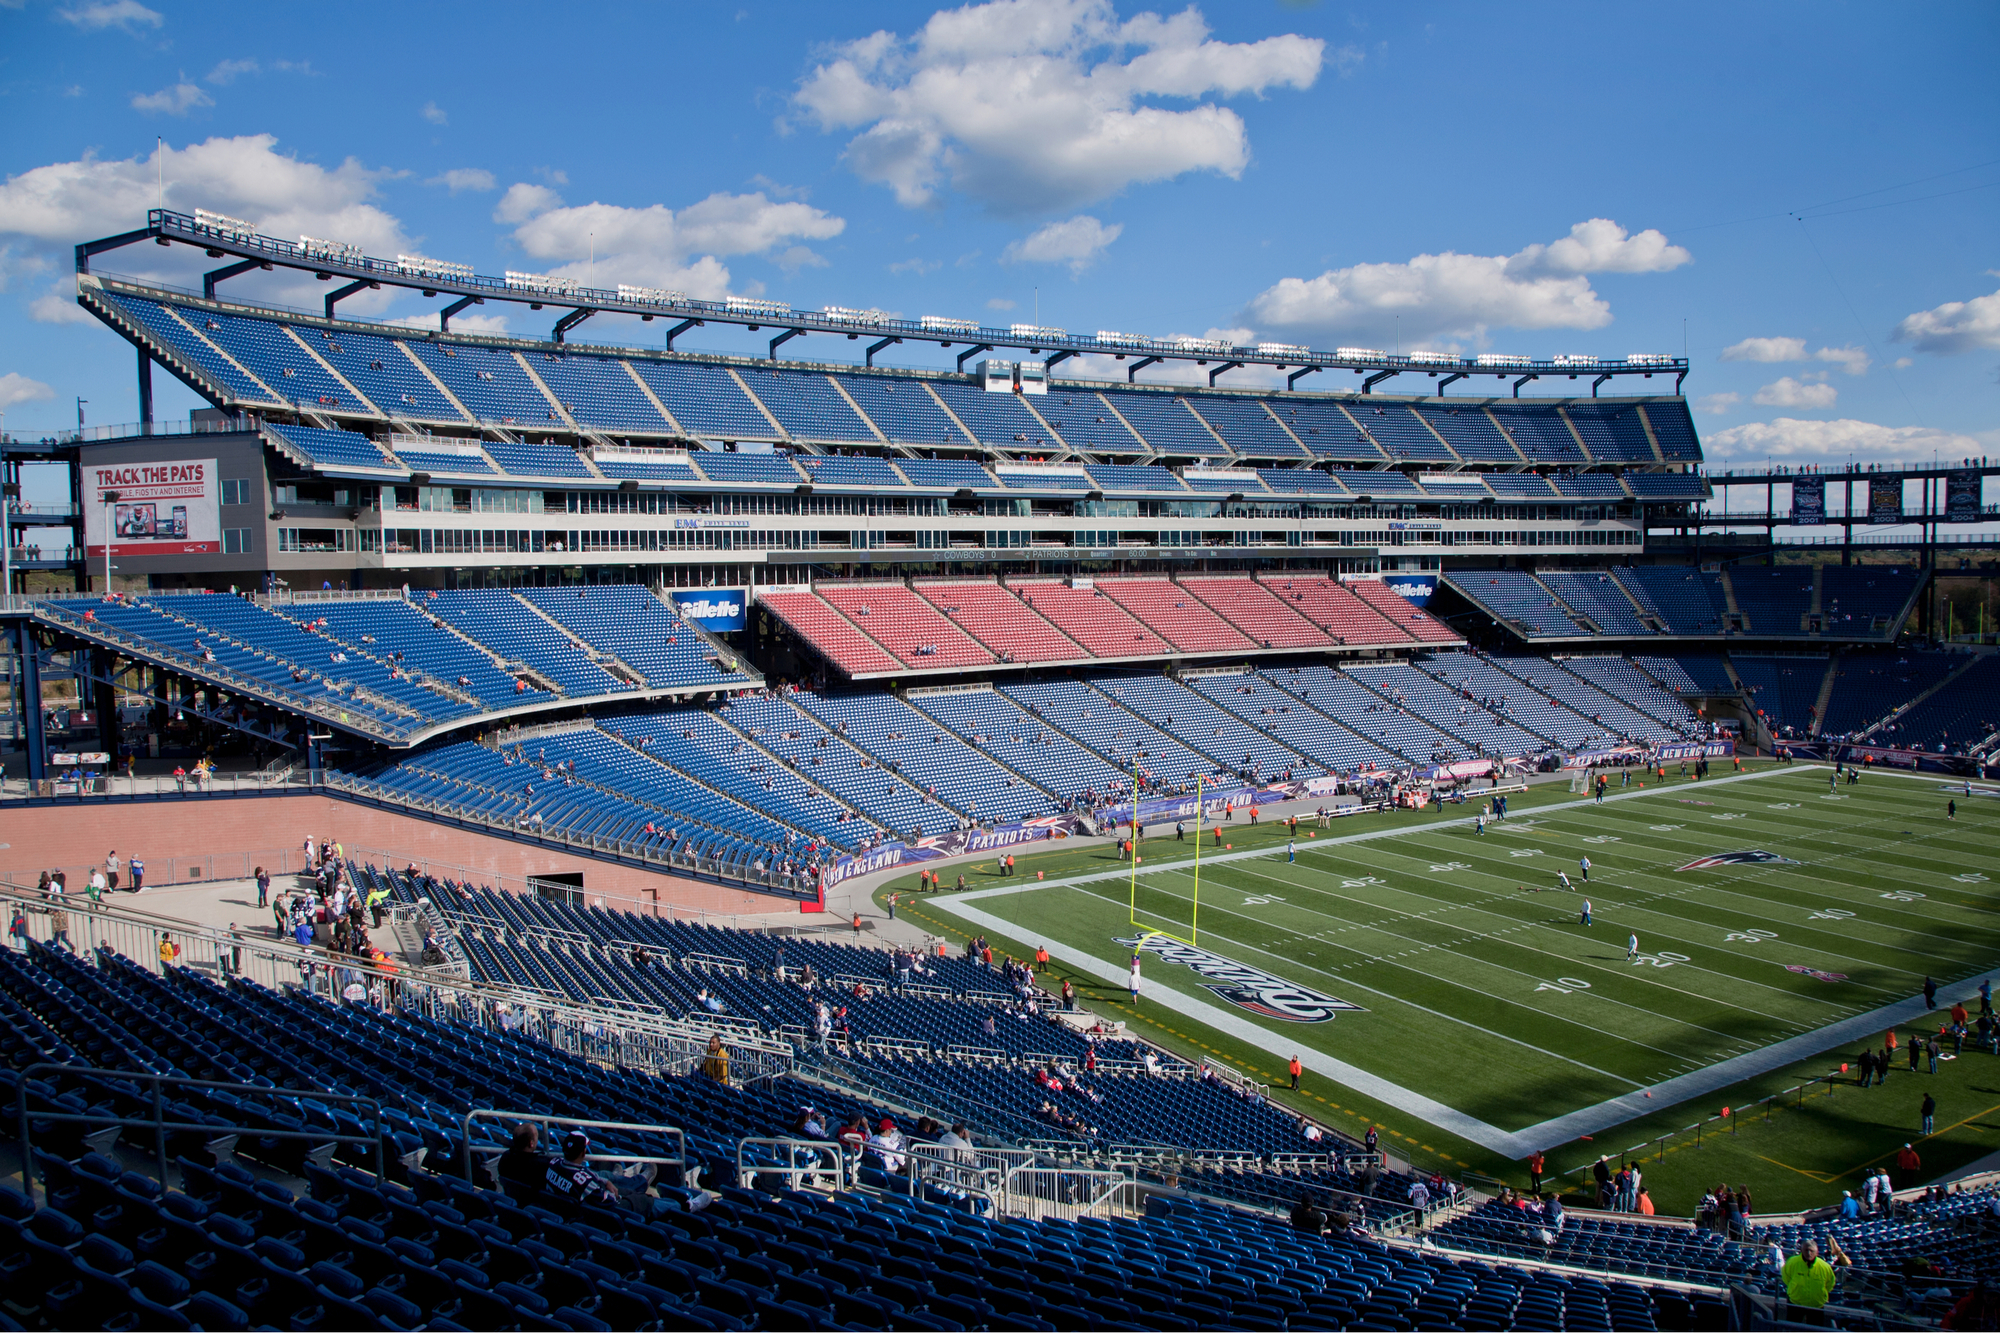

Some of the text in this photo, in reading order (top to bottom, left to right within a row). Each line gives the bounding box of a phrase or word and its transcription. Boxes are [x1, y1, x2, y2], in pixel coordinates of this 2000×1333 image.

[96, 464, 204, 485] TRACK THE PATS
[150, 488, 158, 496] TV
[174, 486, 204, 494] INTERNET
[944, 551, 996, 560] COWBOYS 0
[1032, 550, 1079, 558] PATRIOTS 0
[1390, 583, 1432, 597] Gillette
[681, 600, 739, 618] Gillette
[1662, 745, 1725, 759] NEW ENGAND
[973, 827, 1034, 850] PATRIOTS
[1882, 890, 1926, 901] 50
[1812, 908, 1856, 920] 40
[1729, 929, 1779, 943] 30
[1639, 951, 1691, 968] 20
[1538, 977, 1592, 994] 10
[546, 1167, 573, 1193] WELKER
